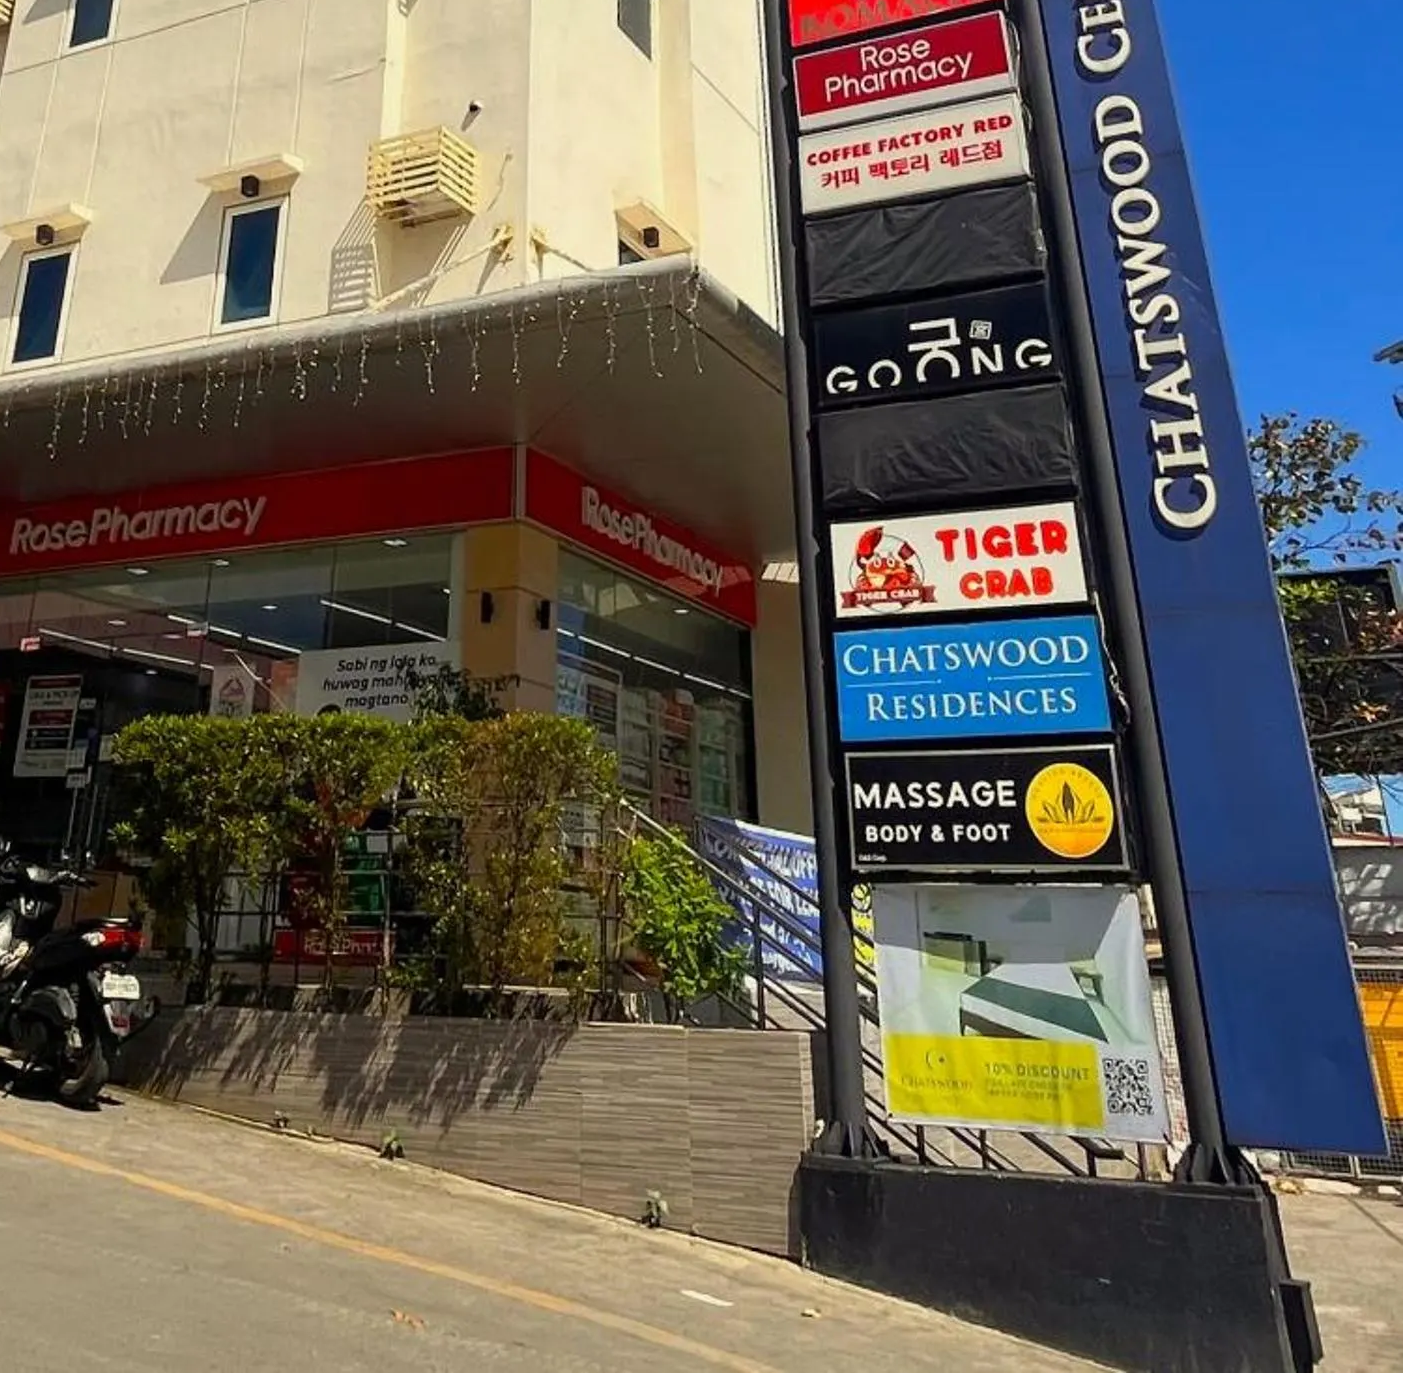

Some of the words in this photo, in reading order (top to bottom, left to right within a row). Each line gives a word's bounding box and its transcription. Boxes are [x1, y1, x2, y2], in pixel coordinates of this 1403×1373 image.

[860, 39, 931, 72] Rose
[824, 51, 973, 103] Pharmacy
[806, 142, 873, 167] COFFEE
[877, 123, 966, 153] FACTORY
[973, 114, 1013, 134] RED
[820, 166, 861, 189] 커피
[939, 139, 1004, 168] 레드점
[1094, 94, 1217, 529] CHATSWOOD
[934, 519, 1069, 563] TIGER
[855, 591, 888, 602] TIGER
[890, 589, 921, 599] CRAB
[959, 566, 1055, 600] CRAB
[842, 635, 1089, 676] CHATSWOOD
[866, 687, 1077, 721] RESIDENCES
[853, 779, 1017, 810] MASSAGE
[865, 824, 924, 842] BODY
[930, 824, 945, 842] &
[953, 823, 1012, 842] FOOT
